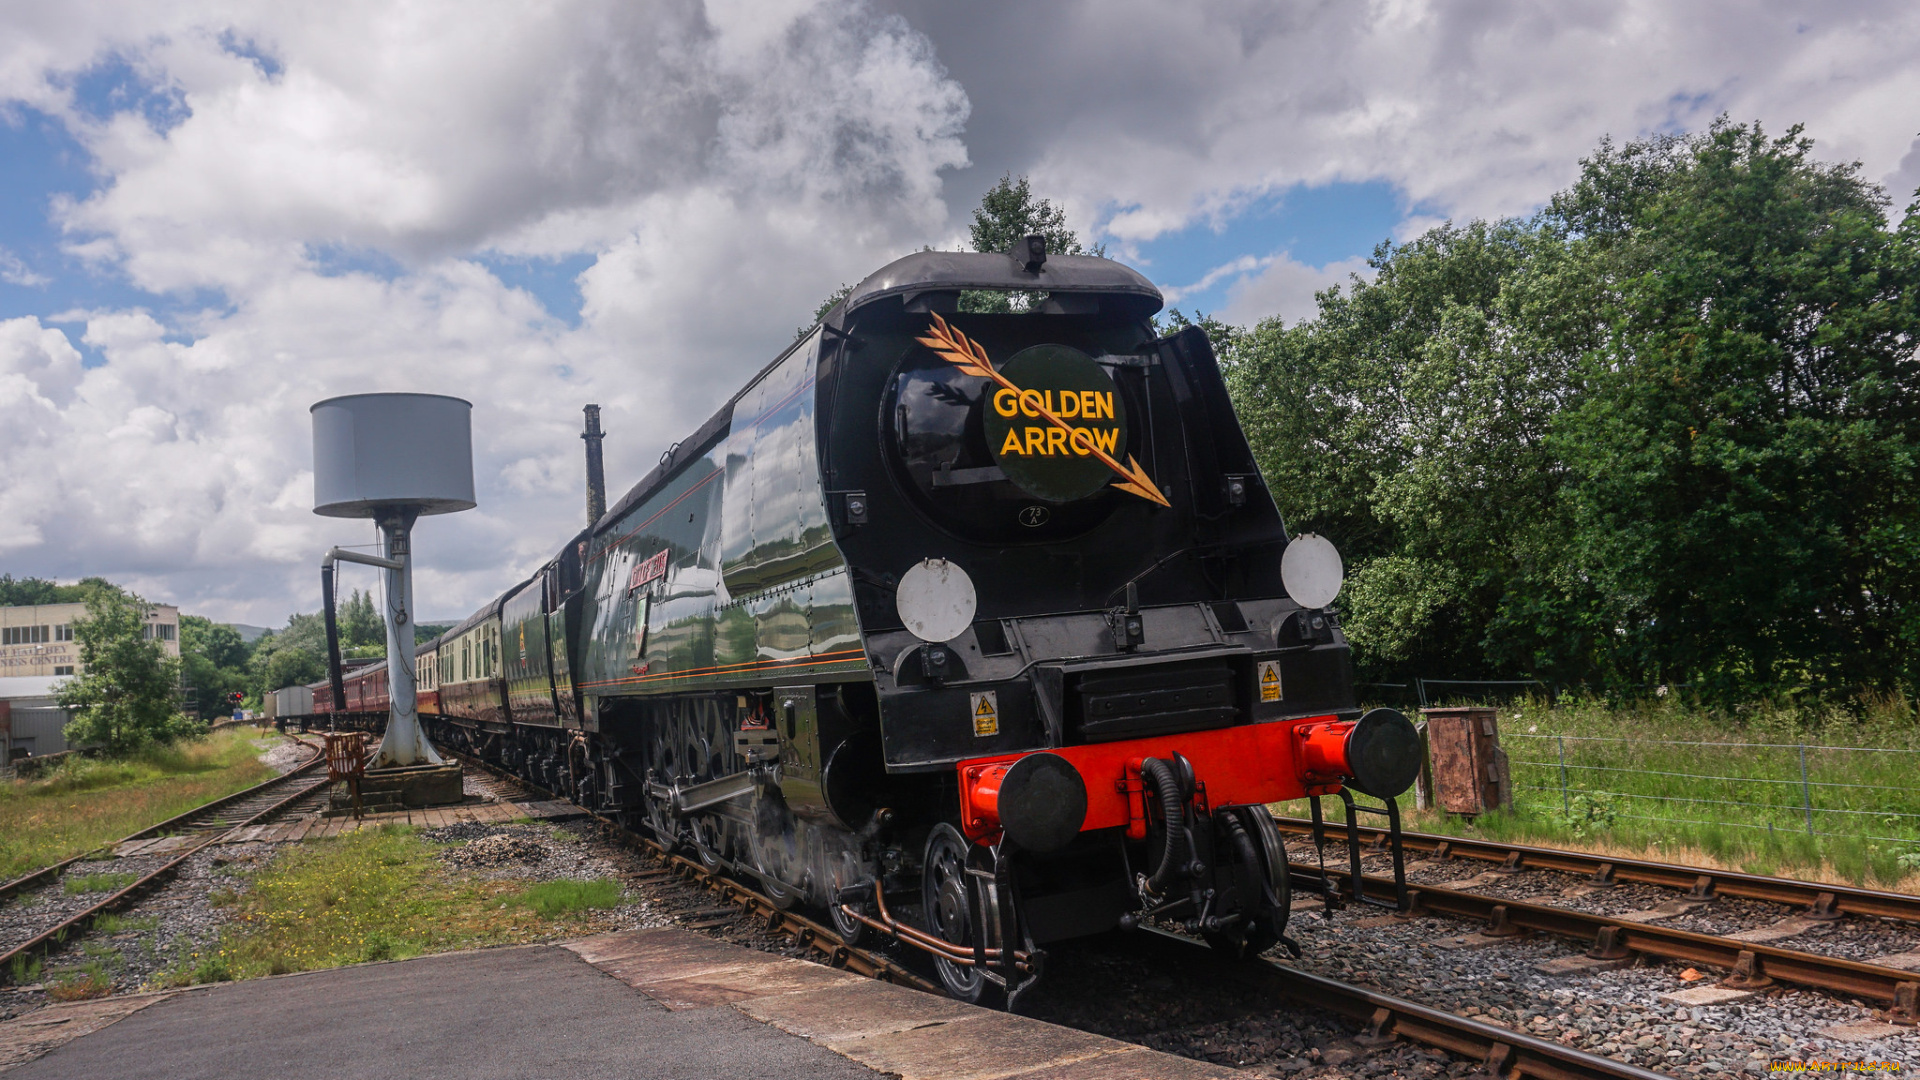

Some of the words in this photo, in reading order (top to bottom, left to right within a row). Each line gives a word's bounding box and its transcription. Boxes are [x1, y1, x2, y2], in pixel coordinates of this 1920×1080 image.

[993, 388, 1115, 419] GOLDEN
[1000, 427, 1120, 456] ARROW
[1030, 507, 1042, 517] 73
[1030, 516, 1038, 525] A
[30, 655, 74, 665] CENTRE
